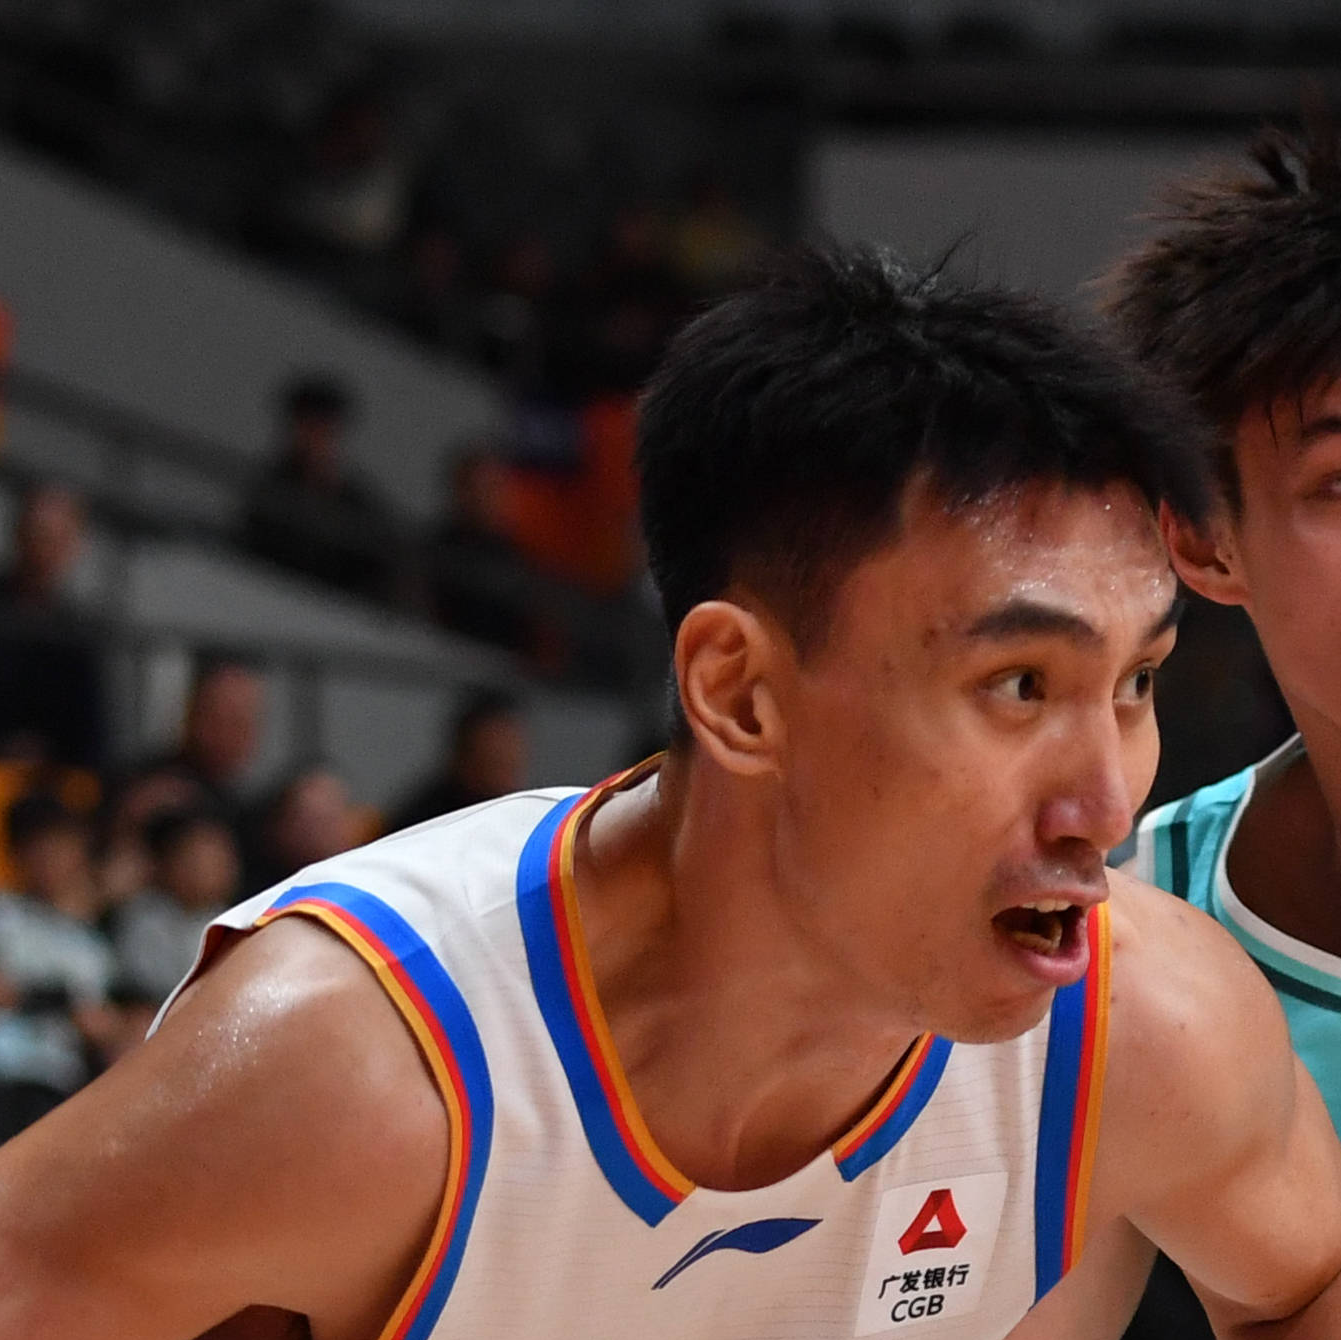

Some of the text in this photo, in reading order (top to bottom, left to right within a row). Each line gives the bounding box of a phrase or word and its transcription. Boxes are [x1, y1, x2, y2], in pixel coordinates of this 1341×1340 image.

[878, 1263, 970, 1299] 广发银行
[891, 1294, 945, 1322] CGB
